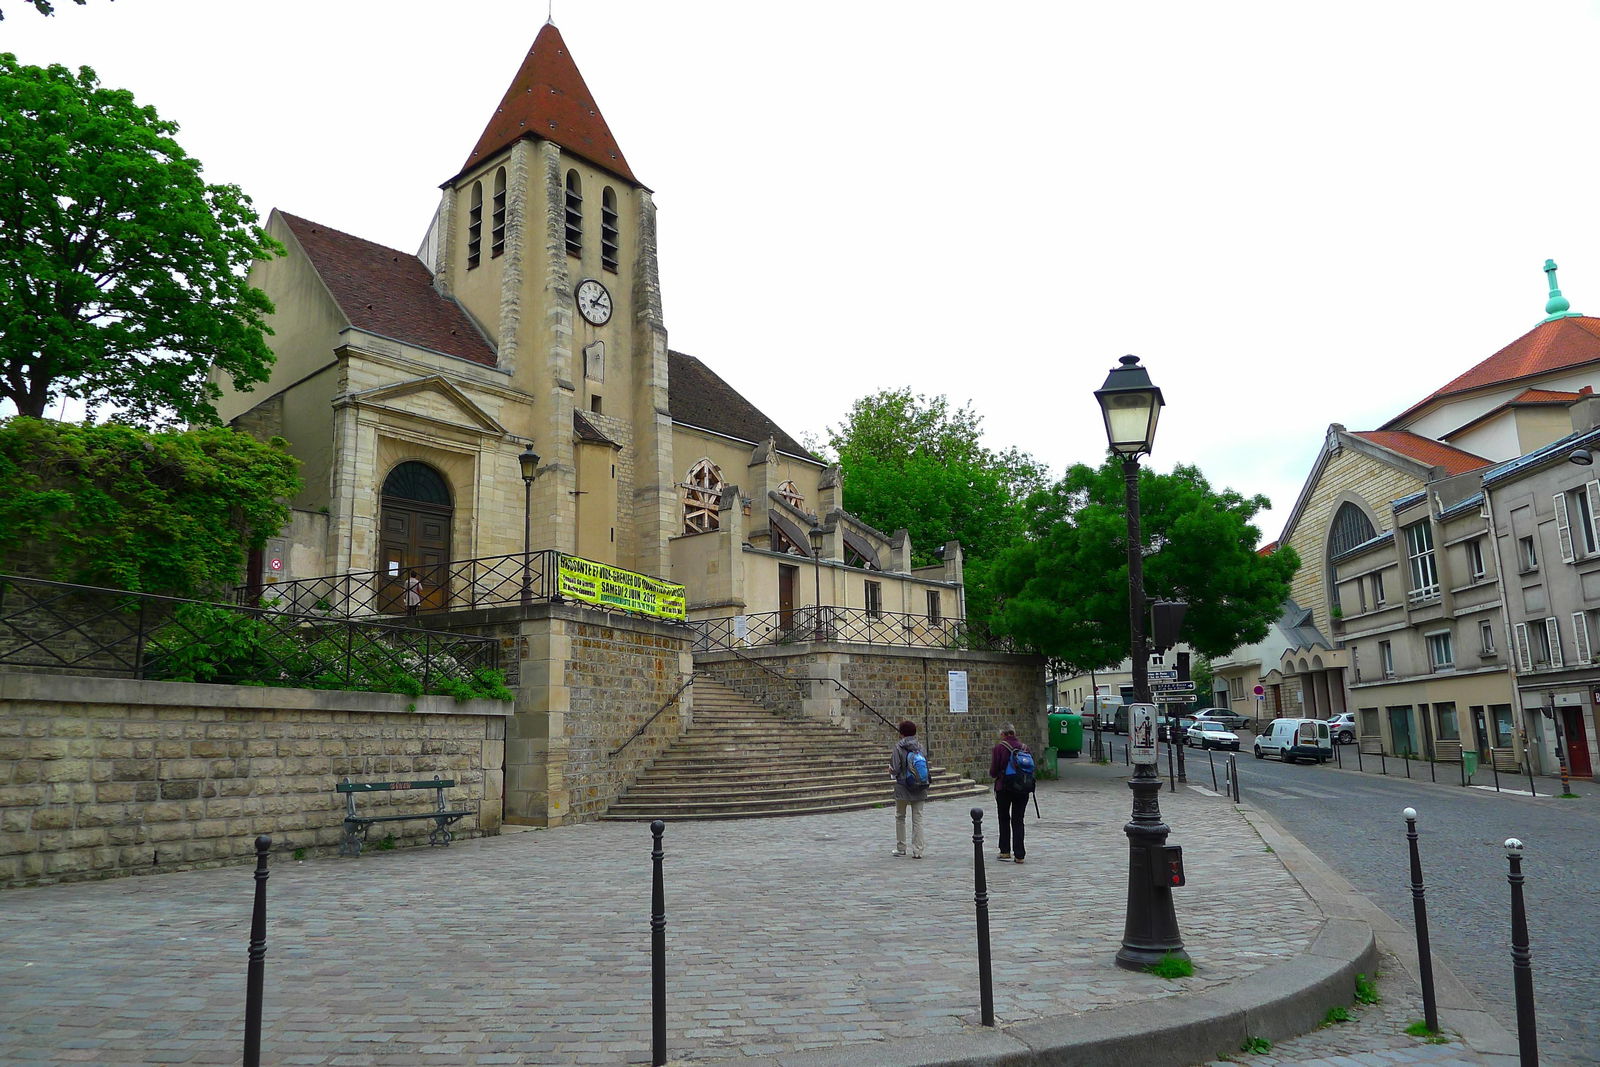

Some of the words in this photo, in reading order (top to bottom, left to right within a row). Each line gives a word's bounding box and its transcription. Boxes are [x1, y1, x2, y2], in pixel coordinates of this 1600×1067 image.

[601, 581, 623, 597] SAMEDI
[624, 587, 629, 598] 2
[629, 590, 640, 601] JUIN
[643, 591, 656, 604] 2012
